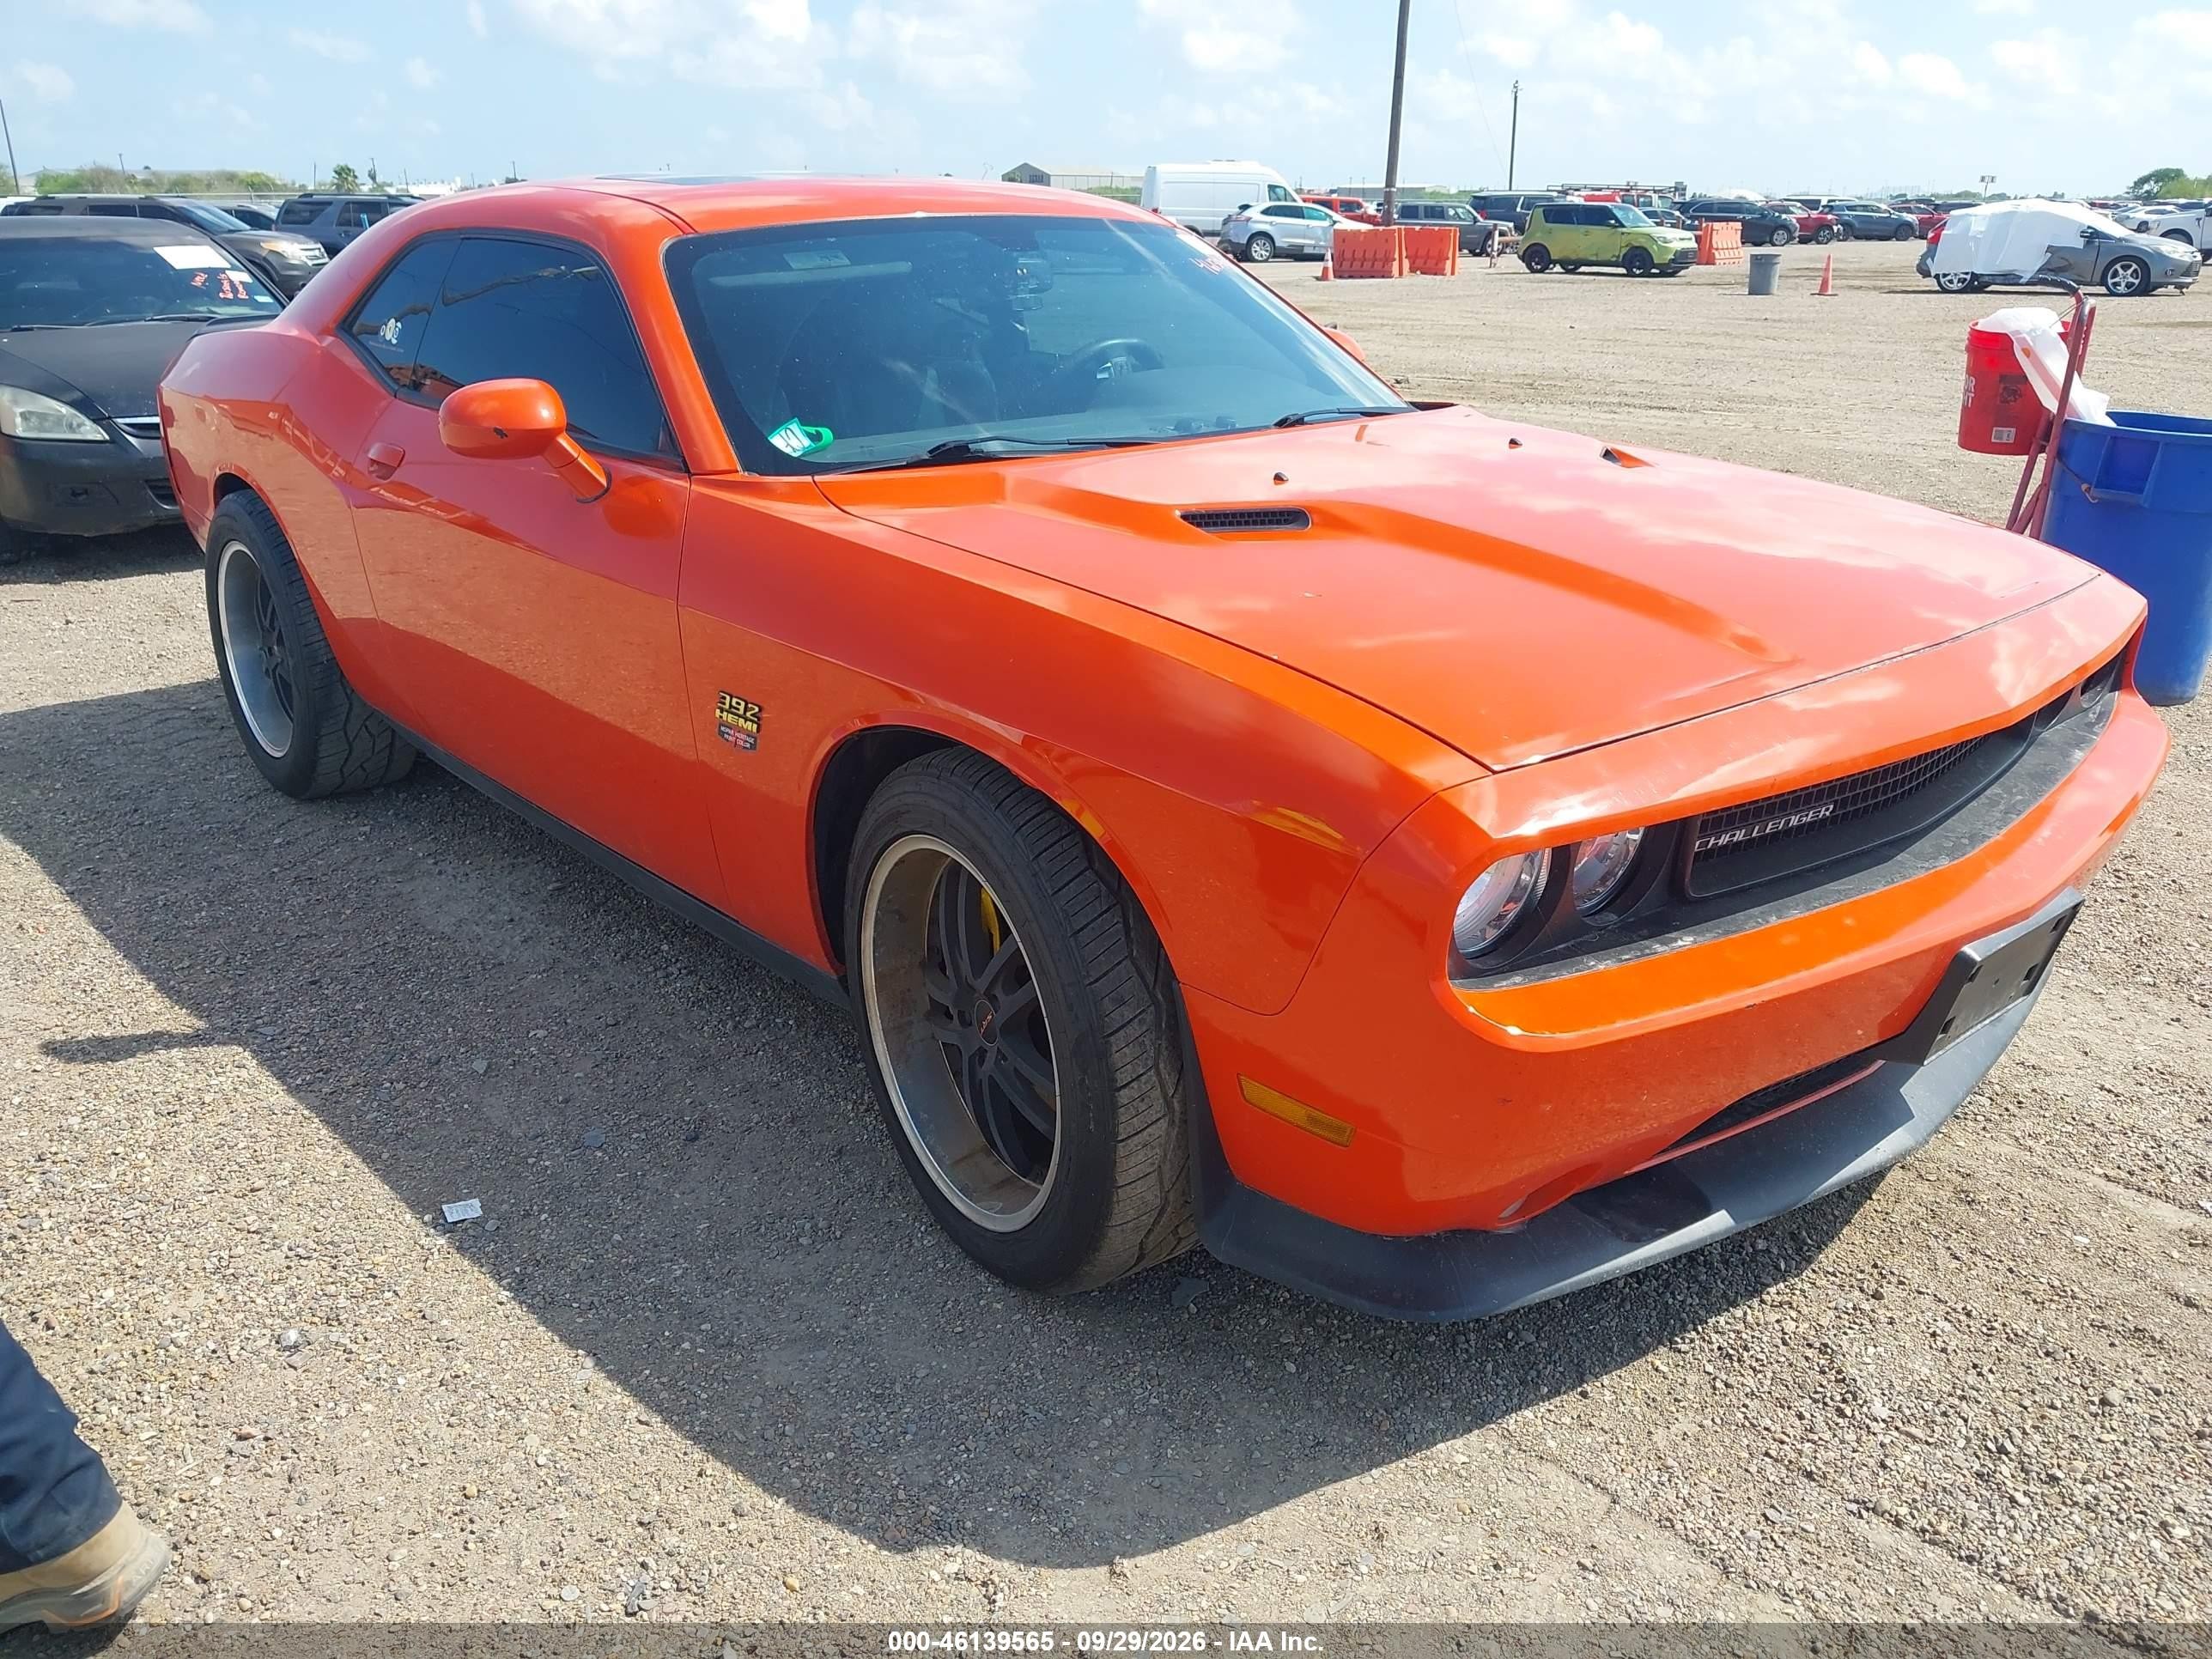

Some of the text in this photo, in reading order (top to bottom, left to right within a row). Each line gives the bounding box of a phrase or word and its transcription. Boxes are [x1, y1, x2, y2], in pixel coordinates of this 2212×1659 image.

[715, 708, 757, 733] HEMI
[717, 691, 759, 721] 392
[1694, 804, 1835, 853] CHALLENGER
